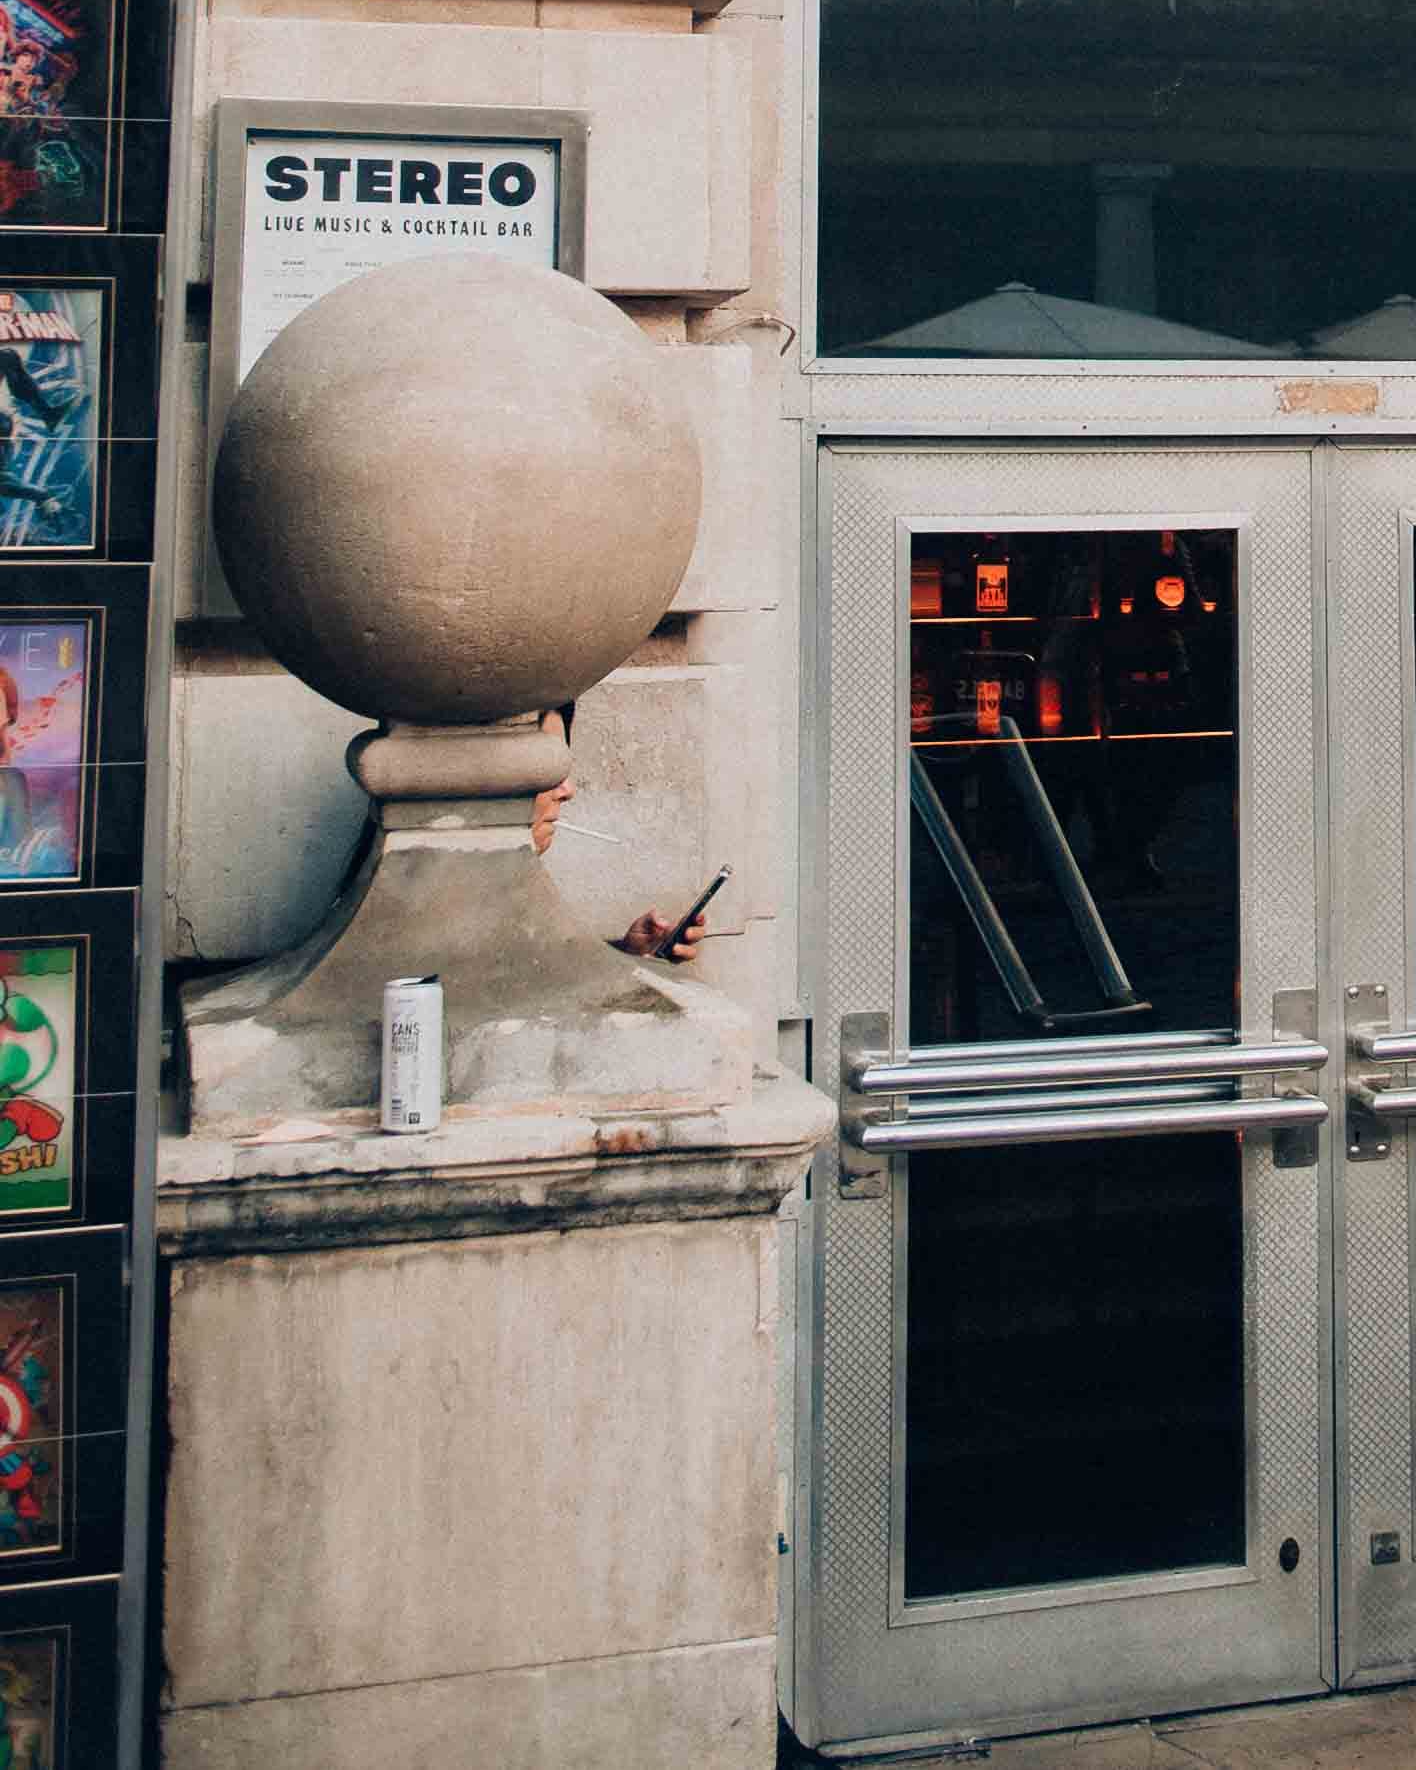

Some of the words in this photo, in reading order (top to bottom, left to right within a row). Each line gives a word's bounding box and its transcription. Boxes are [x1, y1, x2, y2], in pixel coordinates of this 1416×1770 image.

[264, 155, 537, 207] STEREO
[313, 216, 372, 233] MUSIC
[380, 219, 393, 234] &
[402, 219, 488, 236] COCKTAIL
[497, 221, 534, 237] BAR
[392, 1021, 420, 1036] CANS
